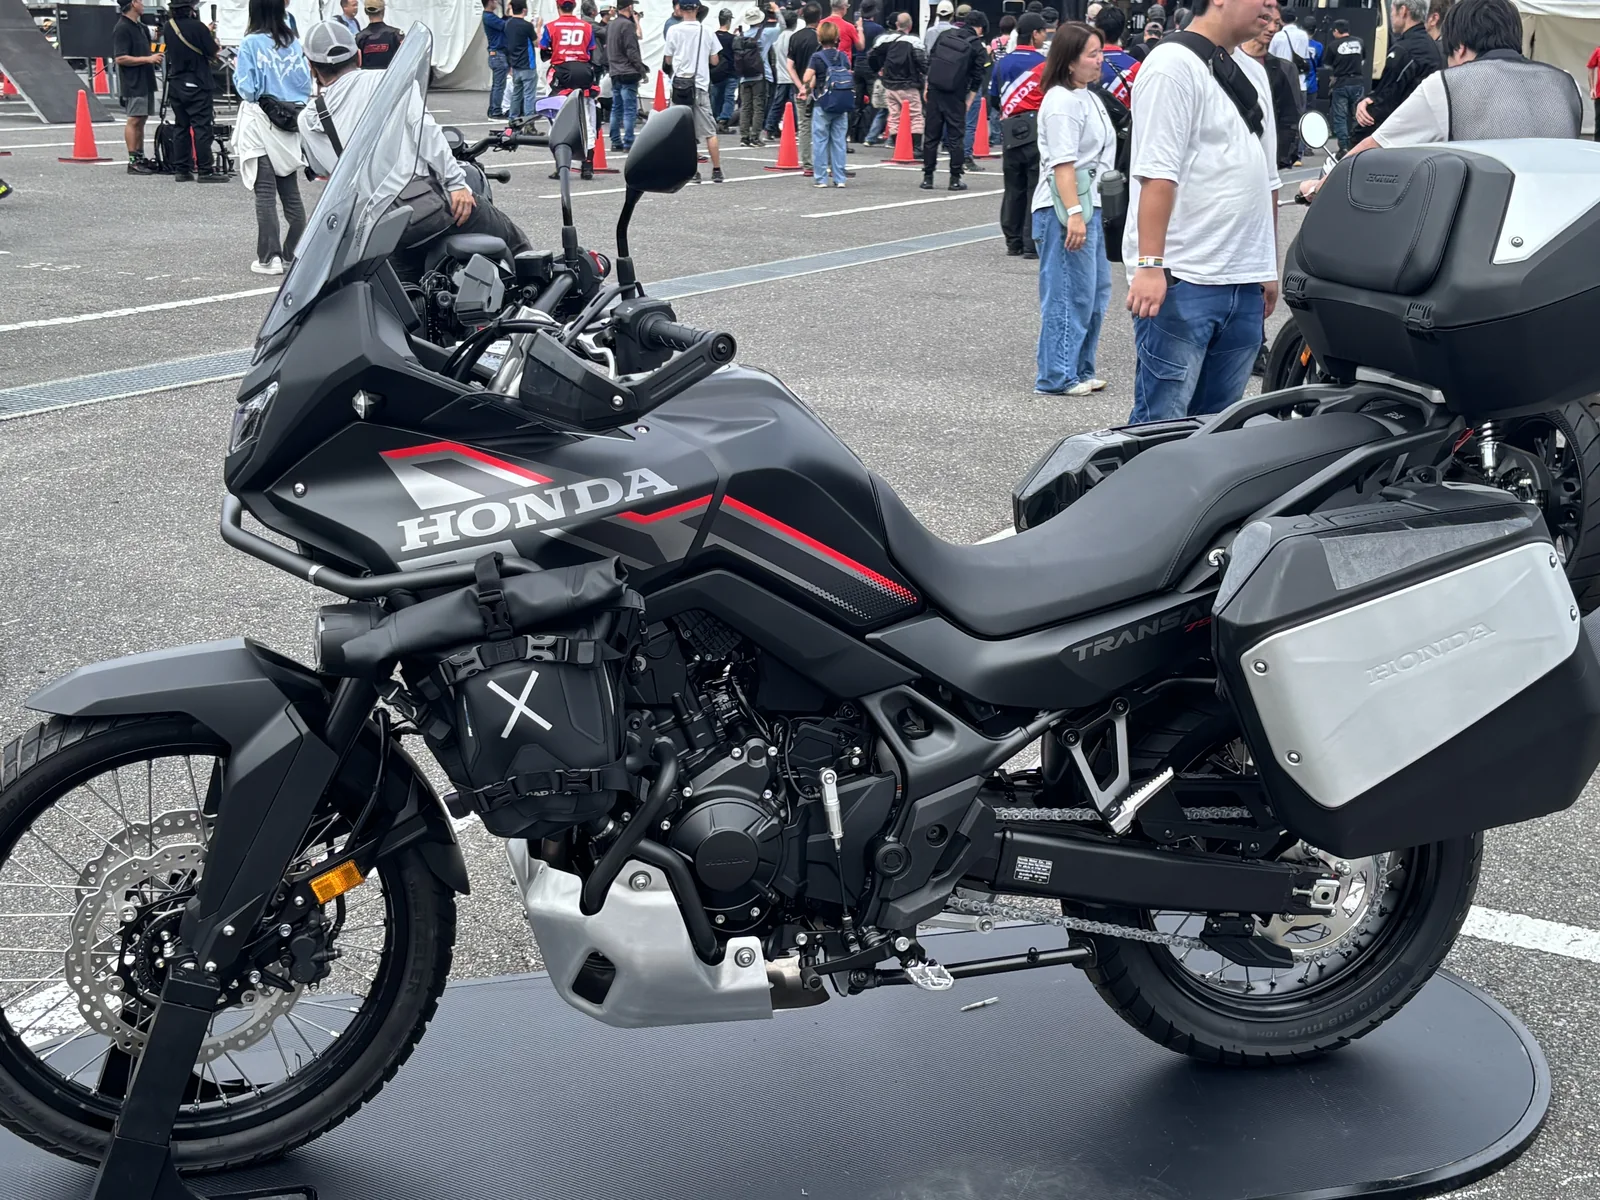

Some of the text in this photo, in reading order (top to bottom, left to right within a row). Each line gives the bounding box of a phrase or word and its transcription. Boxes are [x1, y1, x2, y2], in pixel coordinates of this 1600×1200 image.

[559, 29, 584, 45] 30
[398, 468, 677, 551] HONDA
[1072, 604, 1204, 662] TRANSA
[1184, 616, 1211, 634] 75
[1366, 622, 1497, 684] HONDA
